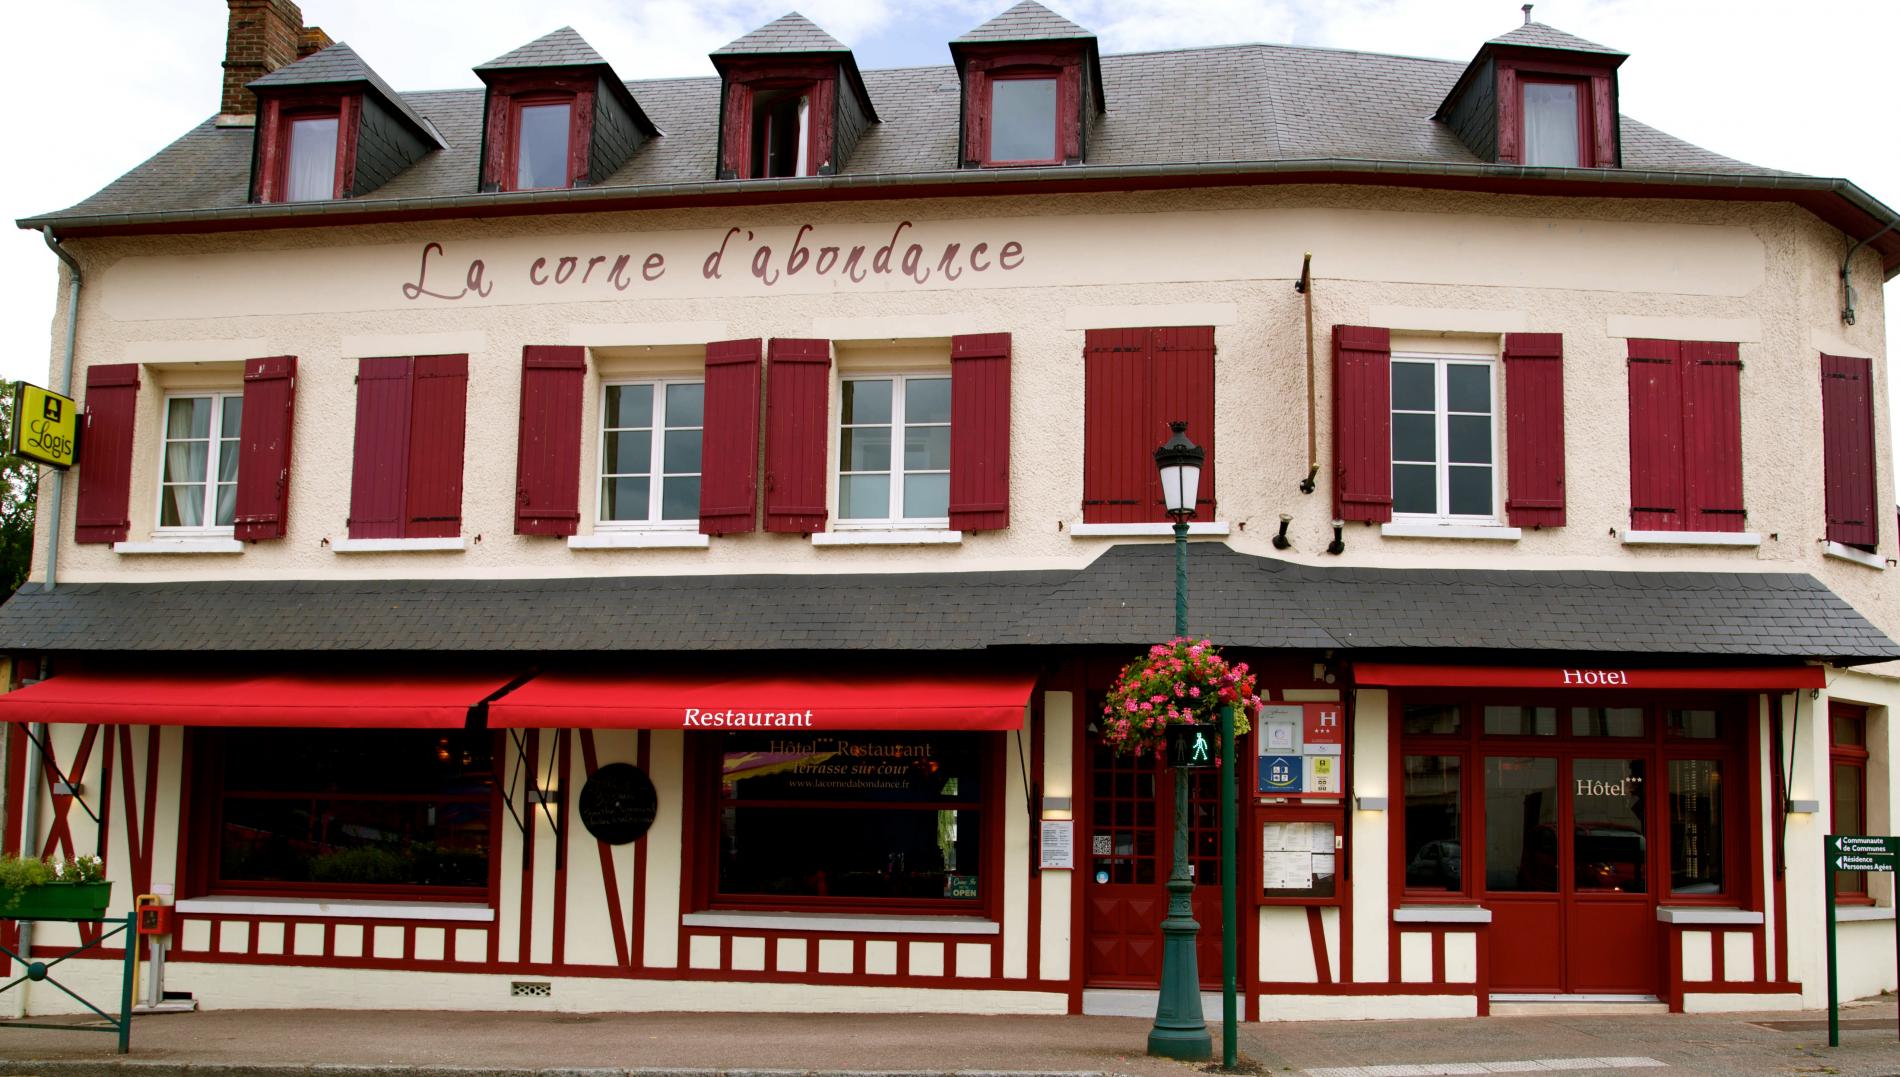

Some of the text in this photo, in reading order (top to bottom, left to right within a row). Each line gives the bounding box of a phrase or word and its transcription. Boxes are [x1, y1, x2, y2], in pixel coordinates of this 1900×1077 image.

[402, 221, 1025, 300] La corne d'abondance
[28, 419, 72, 458] Logis
[683, 708, 813, 727] Restaurant
[1320, 711, 1337, 727] H
[769, 739, 932, 757] Hôtel Restaurant
[791, 762, 910, 775] Terrasse sur cour
[789, 778, 911, 790] www.lacornedabondance.fr
[1576, 779, 1626, 796] Hôtel
[953, 889, 976, 897] OPEN
